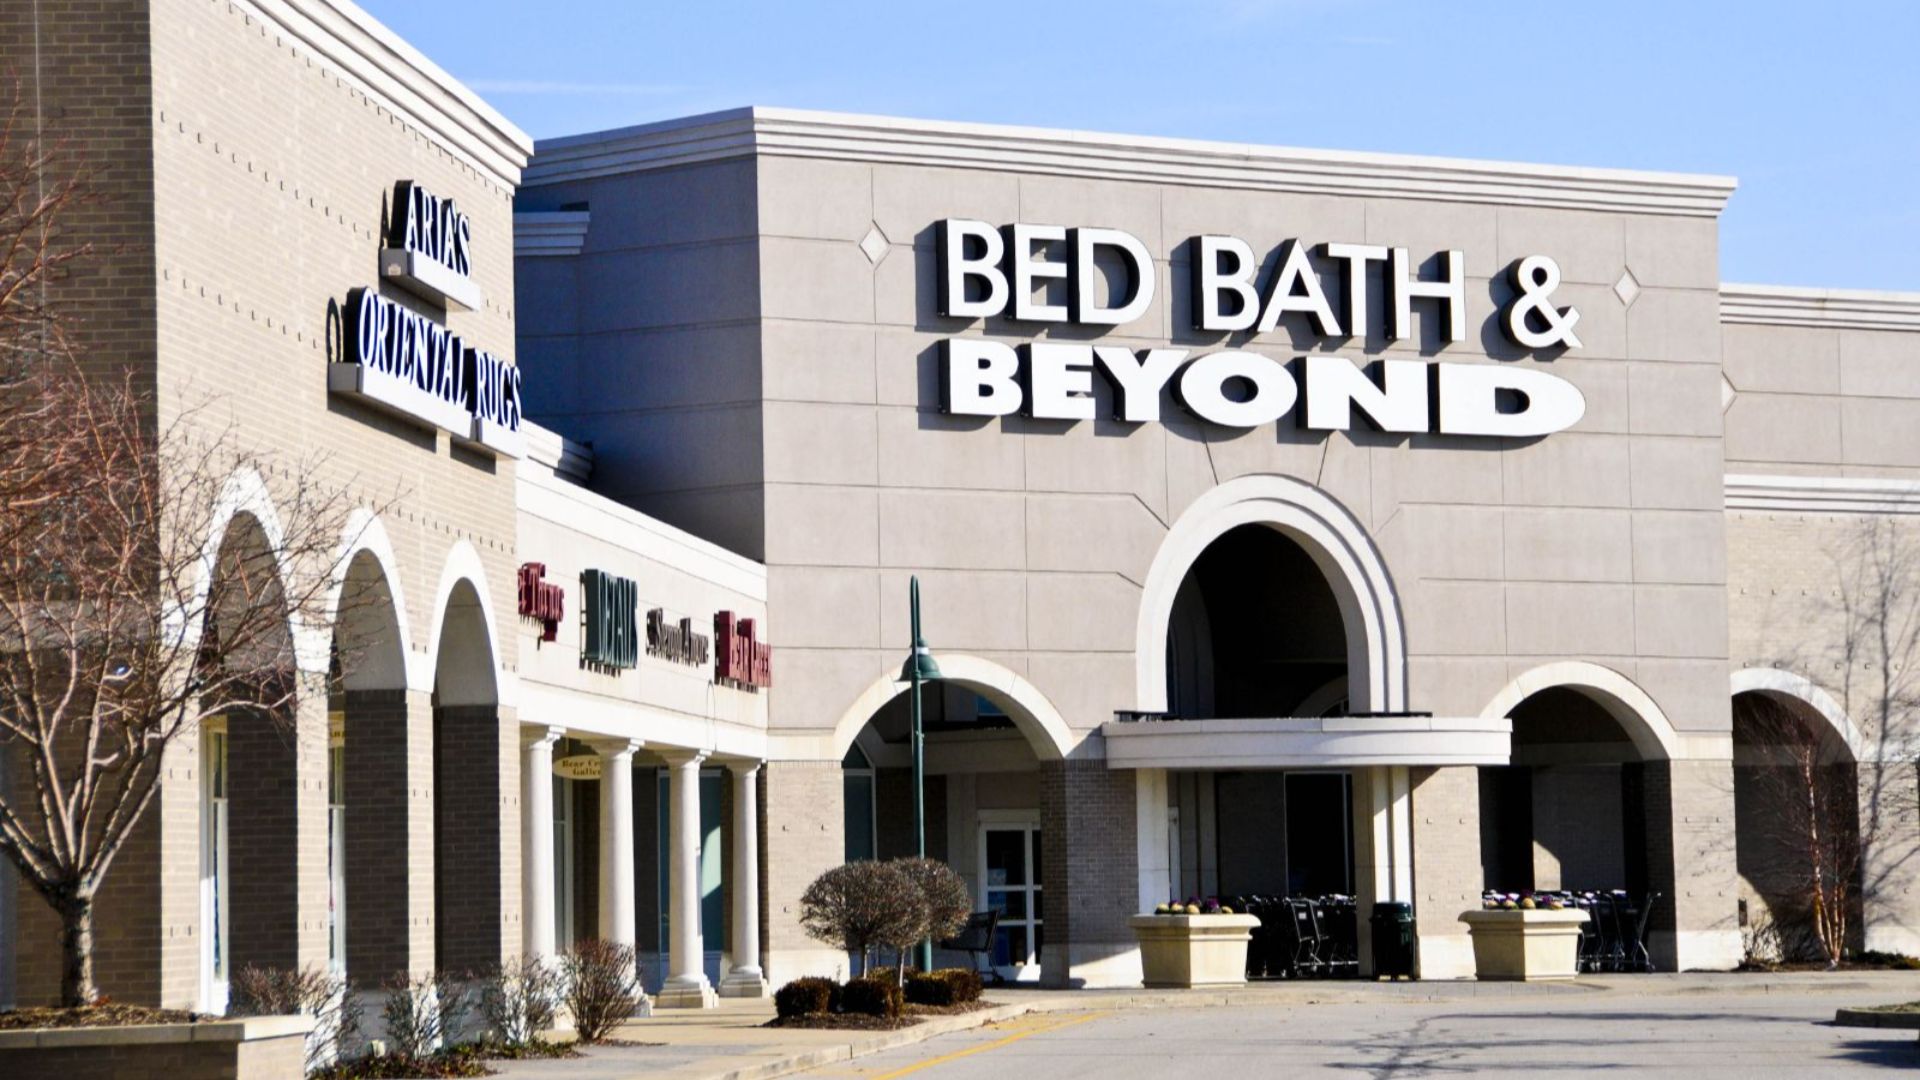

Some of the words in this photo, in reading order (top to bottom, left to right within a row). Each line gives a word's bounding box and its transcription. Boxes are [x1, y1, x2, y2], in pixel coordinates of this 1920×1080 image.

[405, 182, 472, 277] ARIA'S
[944, 218, 1156, 325] BED
[1199, 234, 1467, 342] BATH
[1506, 253, 1584, 350] &
[358, 287, 470, 405] ORIENTAL
[475, 348, 522, 432] RUGS
[945, 338, 1587, 437] BEYOND
